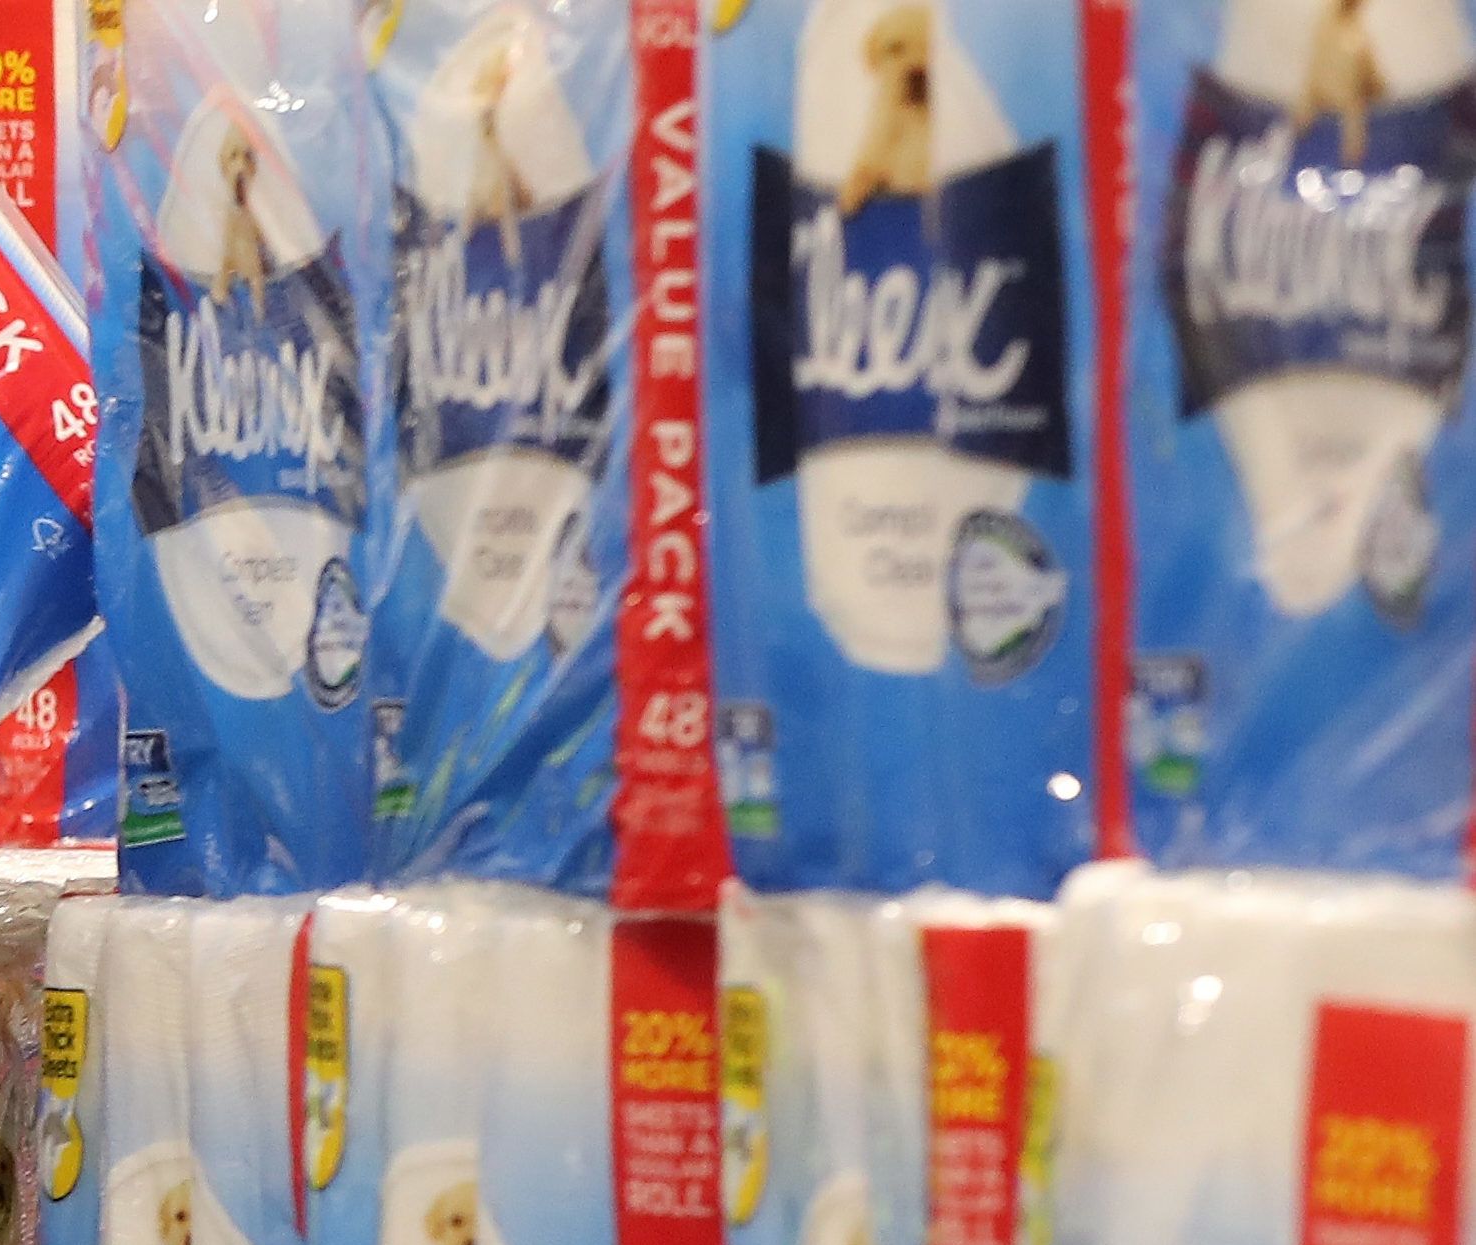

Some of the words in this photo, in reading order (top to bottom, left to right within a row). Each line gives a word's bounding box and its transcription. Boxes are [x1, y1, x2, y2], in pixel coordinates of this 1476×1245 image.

[650, 97, 698, 381] VALUE
[51, 382, 98, 442] 48
[646, 419, 698, 643] PACK
[14, 687, 59, 731] 48
[636, 690, 710, 749] 48
